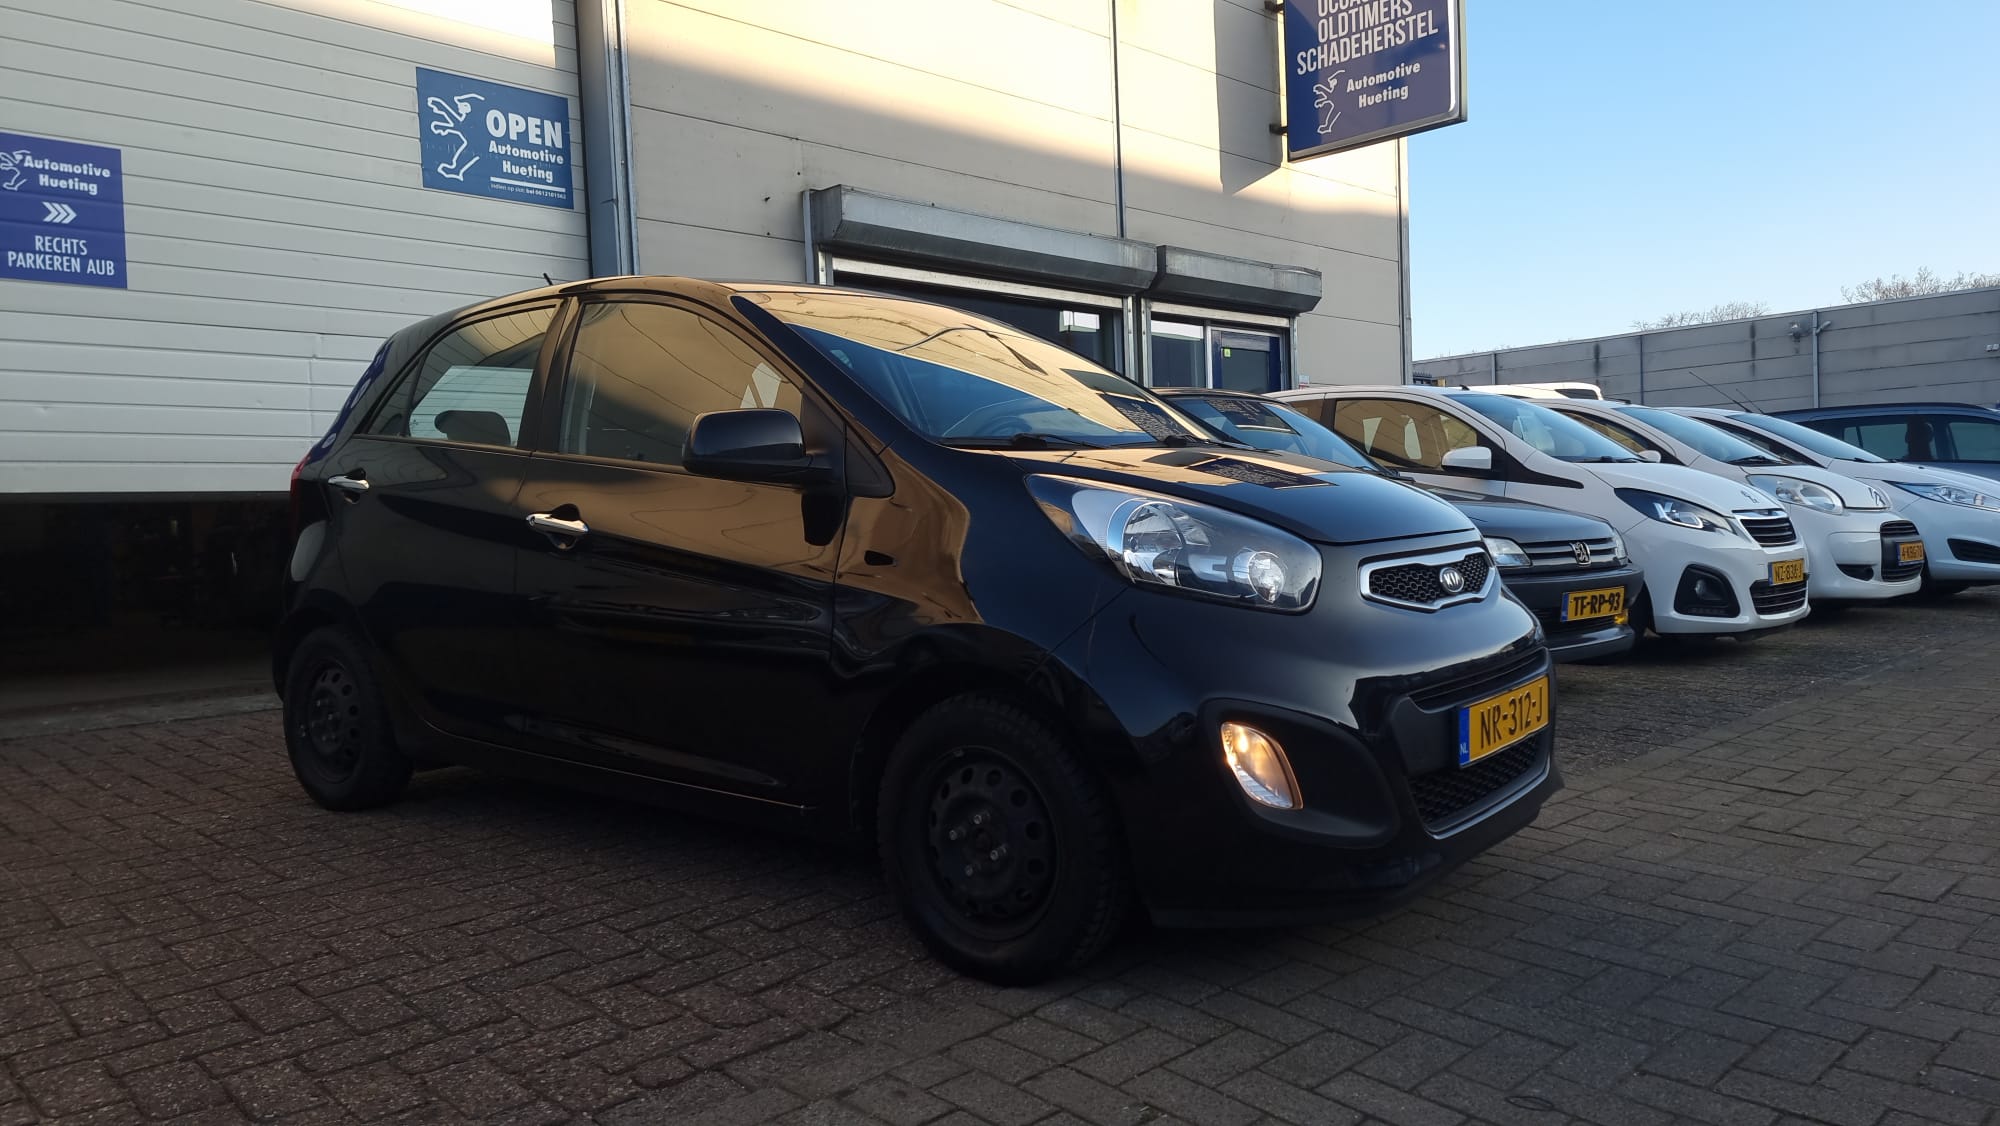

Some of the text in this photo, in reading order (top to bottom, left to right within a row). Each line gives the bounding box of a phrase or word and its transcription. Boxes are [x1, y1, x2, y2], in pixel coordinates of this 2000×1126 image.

[1318, 0, 1412, 43] OLDTIMERS
[1297, 9, 1439, 75] SCHADEHERSTEL
[1347, 61, 1421, 93] Automotive
[1358, 85, 1409, 109] Hueting
[486, 109, 563, 149] OPEN
[488, 140, 564, 165] Automotive
[23, 155, 111, 178] Automotive
[502, 160, 553, 183] Hueting
[38, 174, 98, 196] Hueting
[34, 235, 88, 256] RECHTS
[7, 251, 115, 276] PARKEREN AUB
[1573, 591, 1621, 617] TF-RP-93
[1460, 685, 1543, 756] NL NR-312-J
